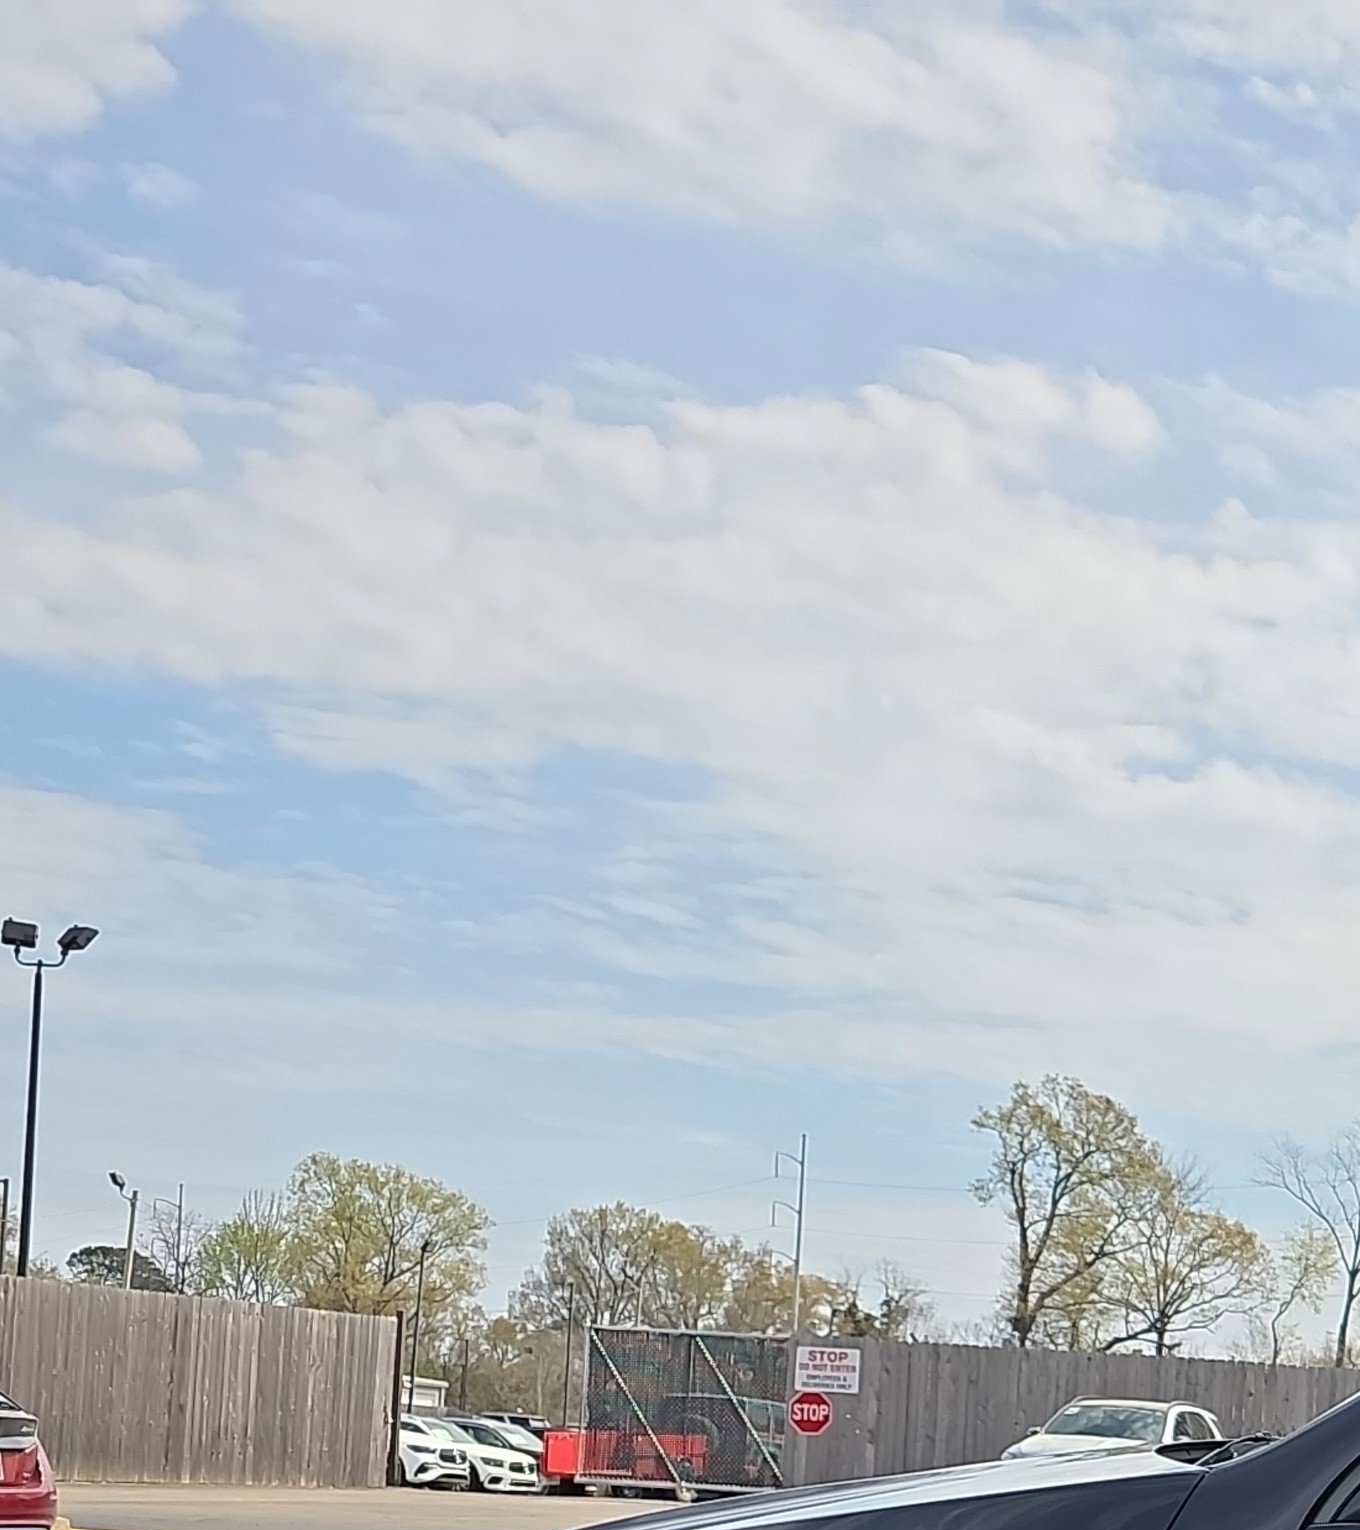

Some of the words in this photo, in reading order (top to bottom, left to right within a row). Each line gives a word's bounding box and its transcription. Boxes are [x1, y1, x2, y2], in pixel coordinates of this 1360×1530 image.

[808, 1350, 849, 1363] STOP
[799, 1363, 810, 1371] DO
[812, 1363, 828, 1372] NOT
[830, 1364, 857, 1373] ENTER
[792, 1403, 829, 1422] STOP
